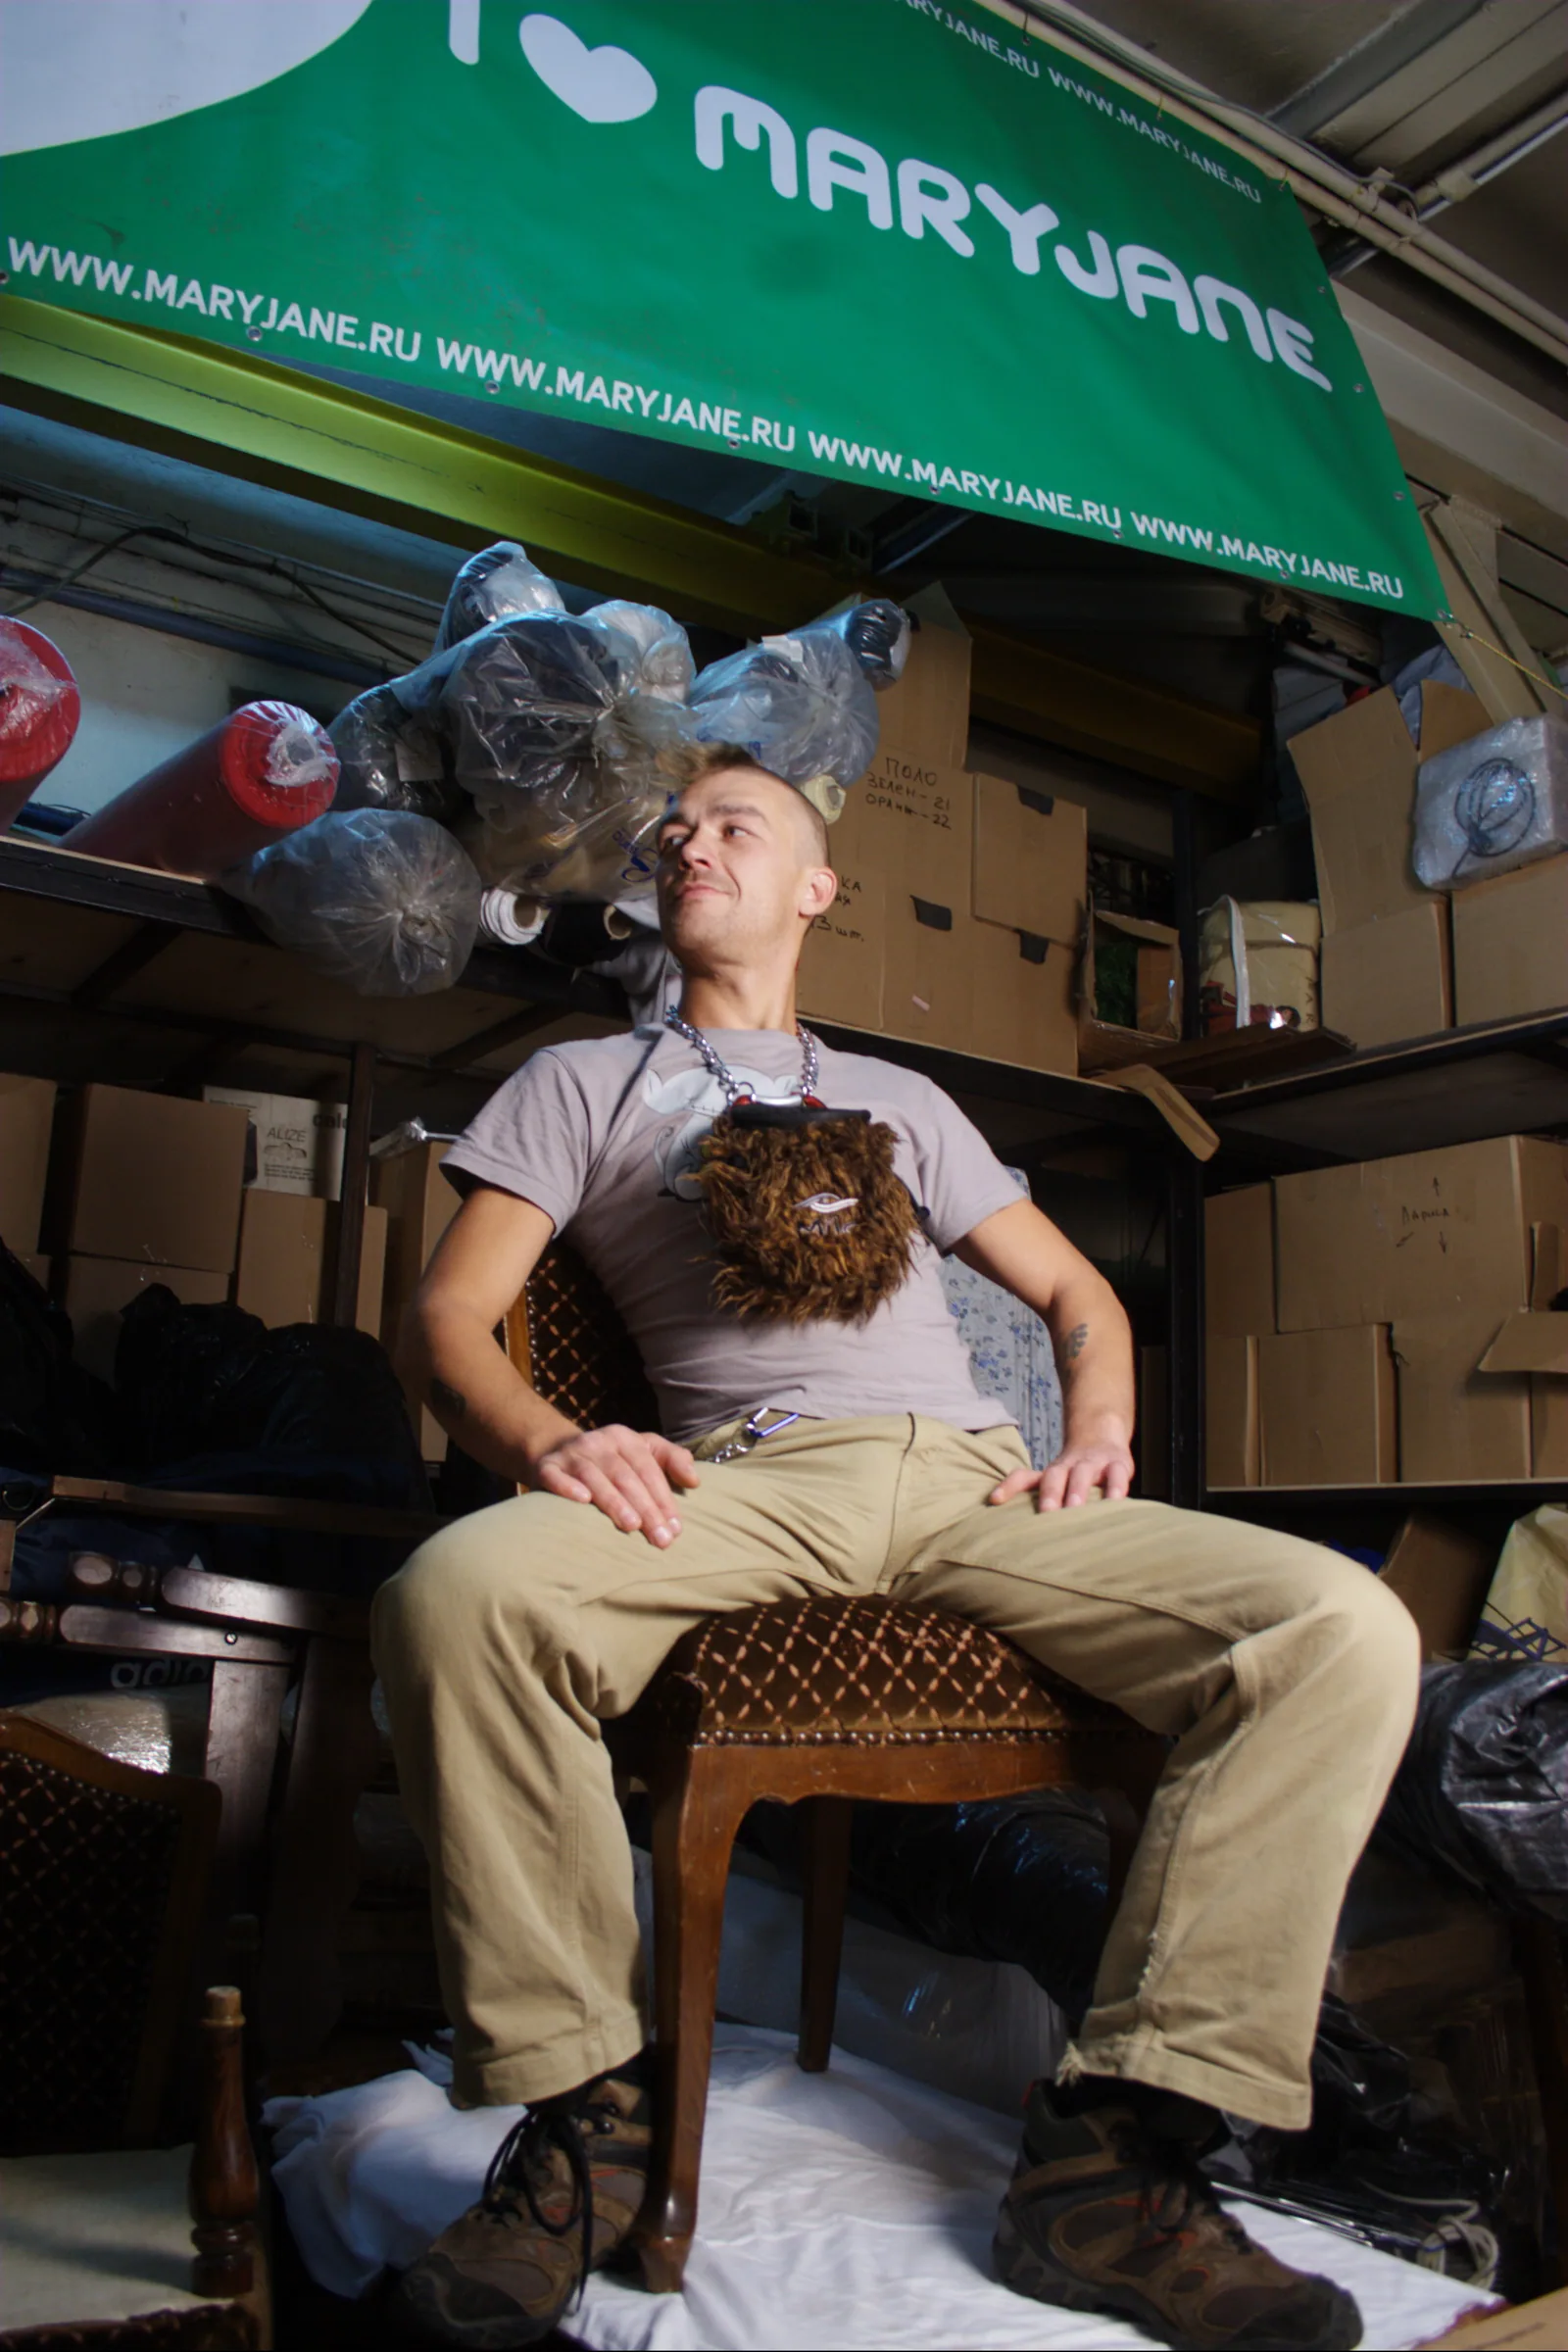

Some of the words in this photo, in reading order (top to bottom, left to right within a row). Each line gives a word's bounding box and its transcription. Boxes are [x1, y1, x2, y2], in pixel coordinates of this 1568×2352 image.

[449, 0, 480, 65] I
[694, 85, 1333, 392] MARYJANE
[1048, 67, 1262, 204] WWW.MARYJANE.RU
[8, 237, 421, 362] WWW.MARYJANE.RU
[436, 336, 796, 453] WWW.MARYJANE.RU
[808, 430, 1122, 530] WWW.MARYJANE.RU
[1132, 513, 1403, 599] WWW.MARYJANE.RU
[886, 757, 937, 786] ПОЛО
[267, 1126, 308, 1143] ALIZE
